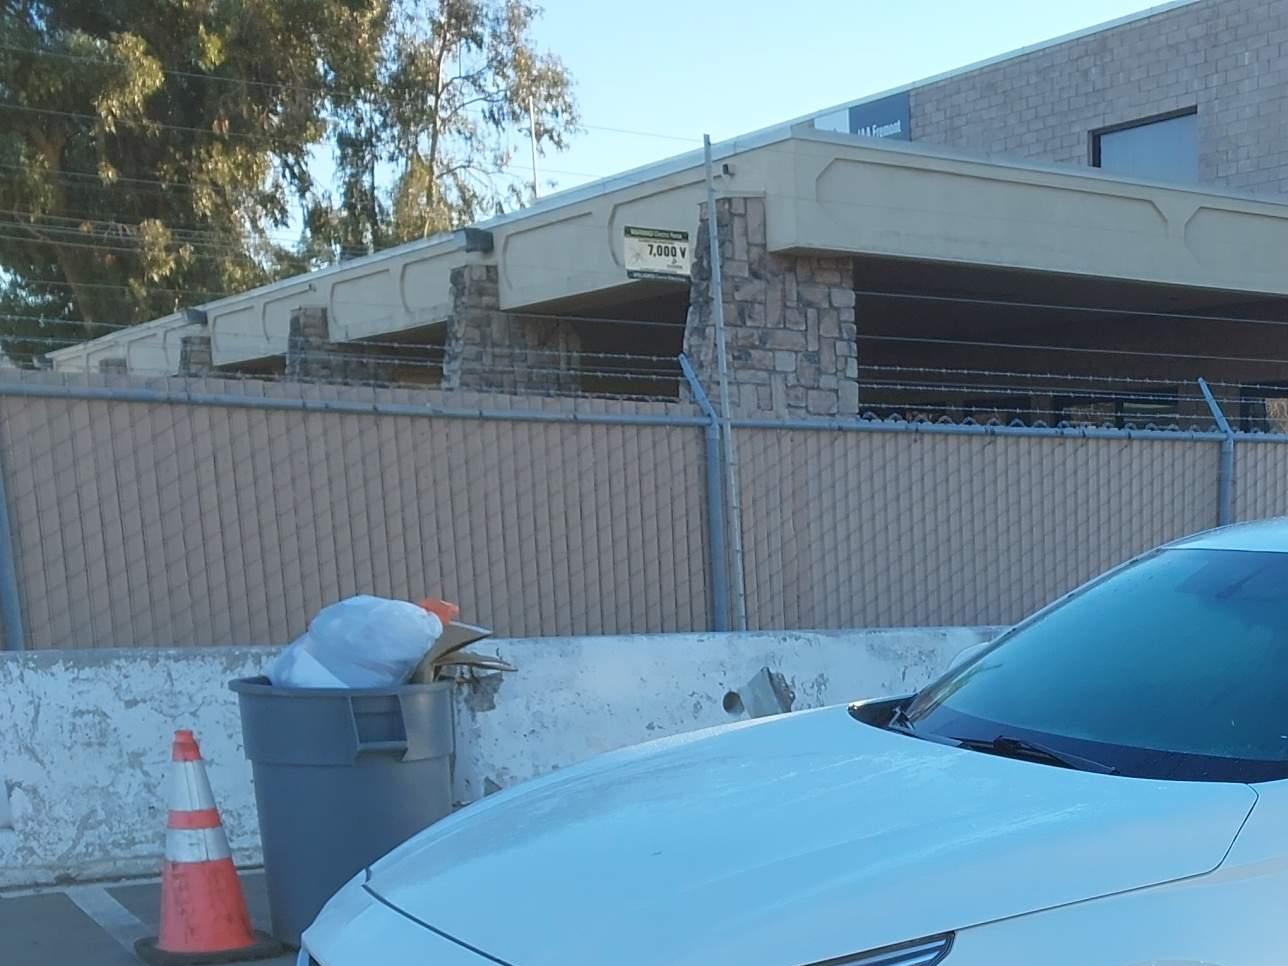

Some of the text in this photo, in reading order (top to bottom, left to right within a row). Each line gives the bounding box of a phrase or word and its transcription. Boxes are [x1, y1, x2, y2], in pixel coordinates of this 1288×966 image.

[872, 119, 902, 138] Fremont
[647, 243, 687, 259] 7,000 V
